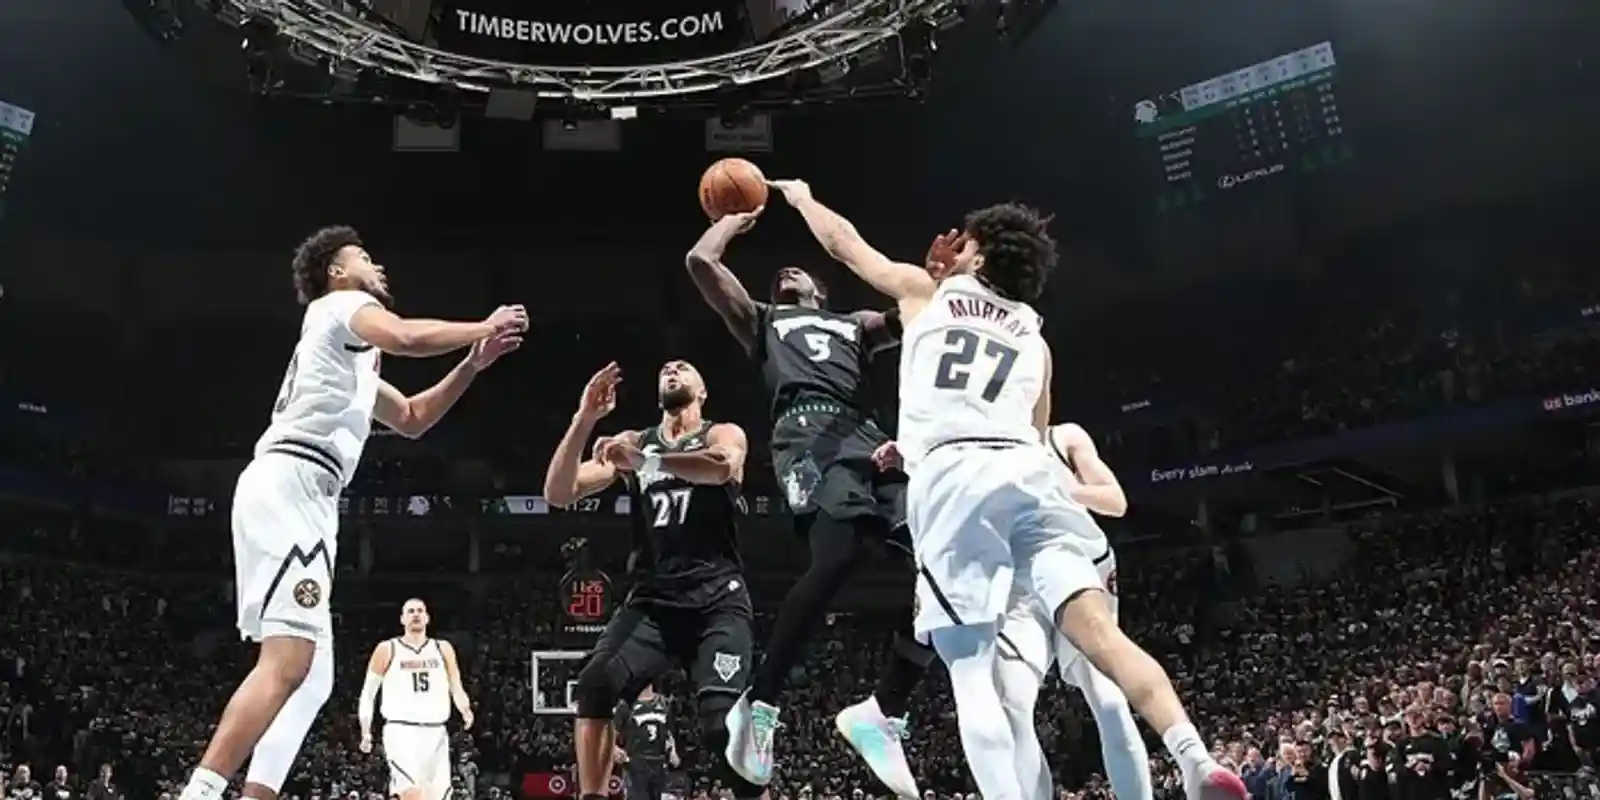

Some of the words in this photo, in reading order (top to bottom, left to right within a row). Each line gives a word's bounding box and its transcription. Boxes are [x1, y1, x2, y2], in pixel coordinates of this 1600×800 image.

[456, 8, 724, 45] TIMBERWOLVES.COM
[948, 299, 1030, 337] MURRAY
[804, 333, 831, 362] 5
[934, 329, 1019, 403] 27
[1151, 468, 1184, 482] Every
[526, 499, 534, 511] 0
[649, 487, 693, 528] 27
[571, 594, 601, 617] 20
[412, 672, 429, 693] 15
